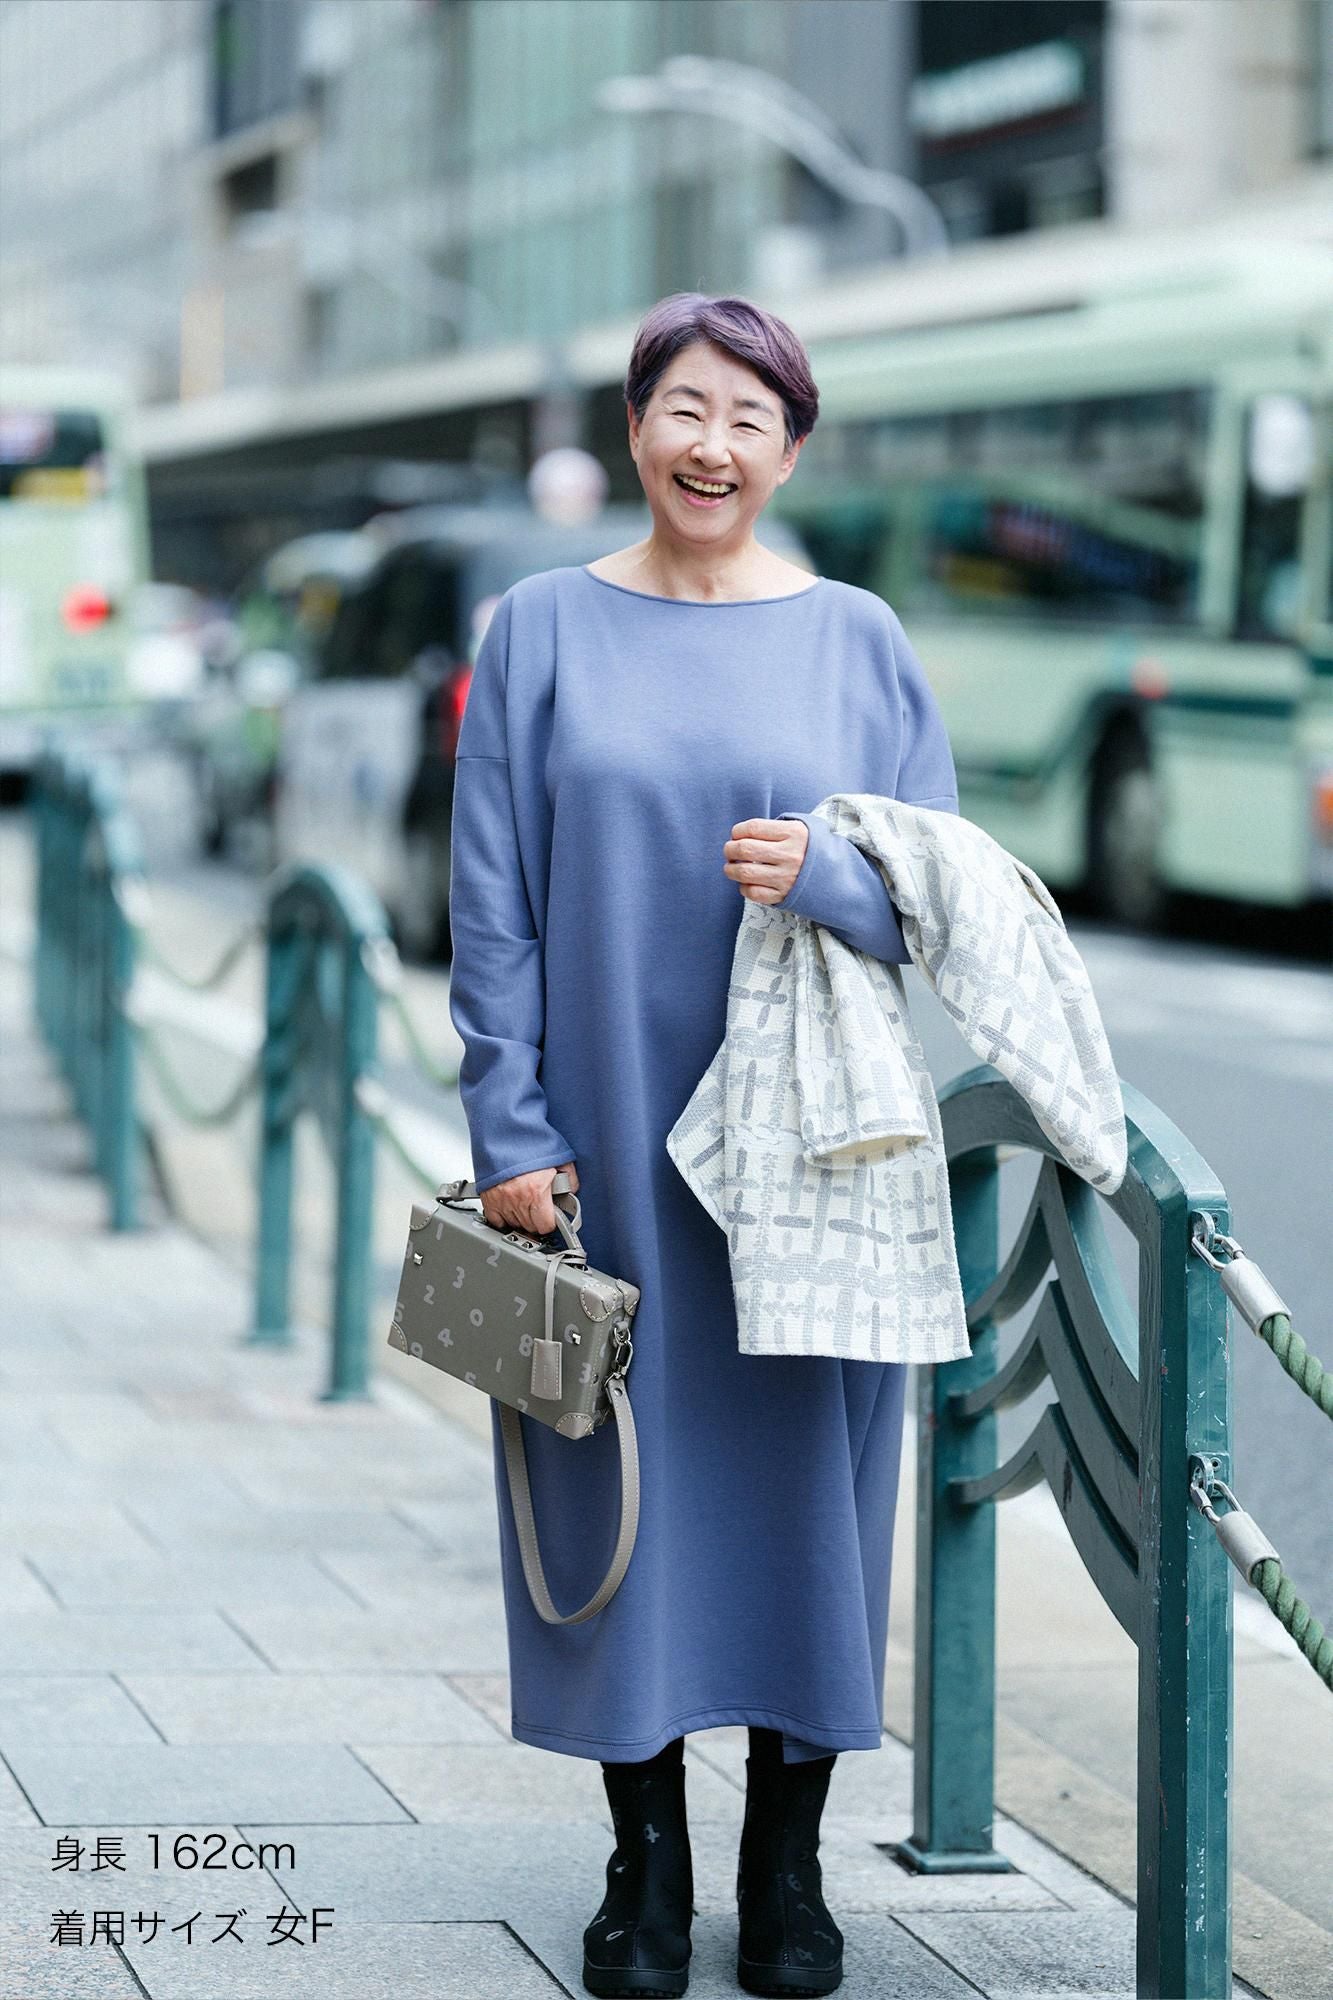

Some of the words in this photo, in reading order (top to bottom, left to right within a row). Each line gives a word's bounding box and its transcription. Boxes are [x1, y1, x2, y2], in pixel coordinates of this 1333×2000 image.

[486, 1243, 501, 1267] 2
[452, 1266, 465, 1289] 3
[423, 1284, 435, 1305] 2
[513, 1296, 528, 1317] 7
[469, 1308, 484, 1327] 0
[437, 1328, 454, 1348] 4
[519, 1333, 533, 1357] 8
[578, 1362, 592, 1383] 3
